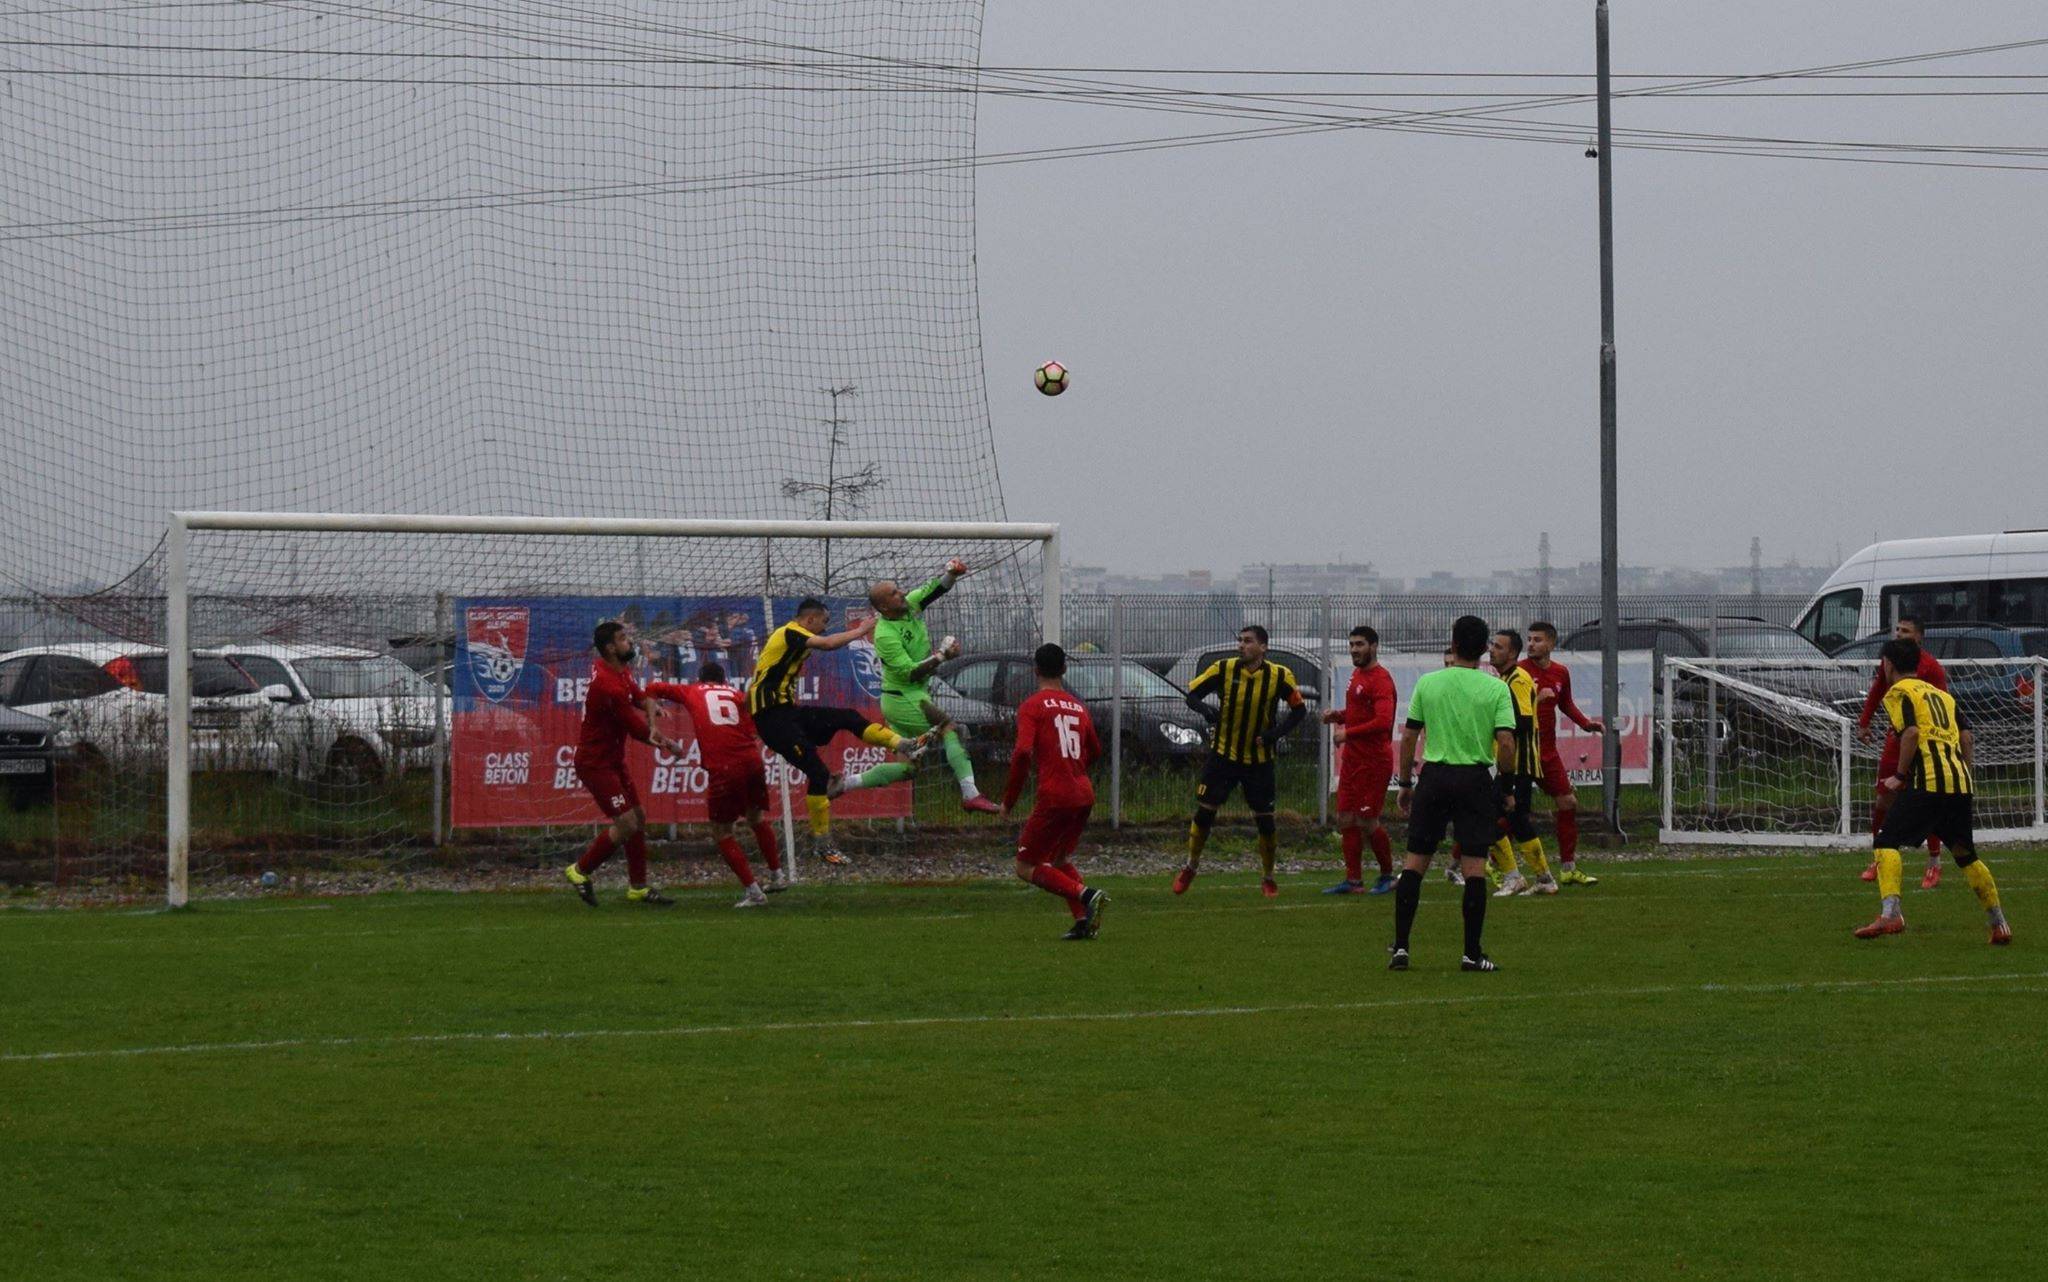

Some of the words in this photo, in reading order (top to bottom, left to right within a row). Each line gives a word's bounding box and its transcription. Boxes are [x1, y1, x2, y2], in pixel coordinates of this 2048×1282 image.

[705, 690, 739, 725] 6
[1923, 692, 1950, 731] 10
[1054, 713, 1081, 760] 16
[486, 752, 529, 768] CLASS
[655, 738, 701, 765] CLA
[843, 746, 887, 762] CLASS
[485, 768, 529, 784] BETON
[651, 766, 709, 793] BETO
[1566, 768, 1584, 782] FAIR
[1585, 768, 1604, 782] PLA
[611, 794, 626, 808] 24
